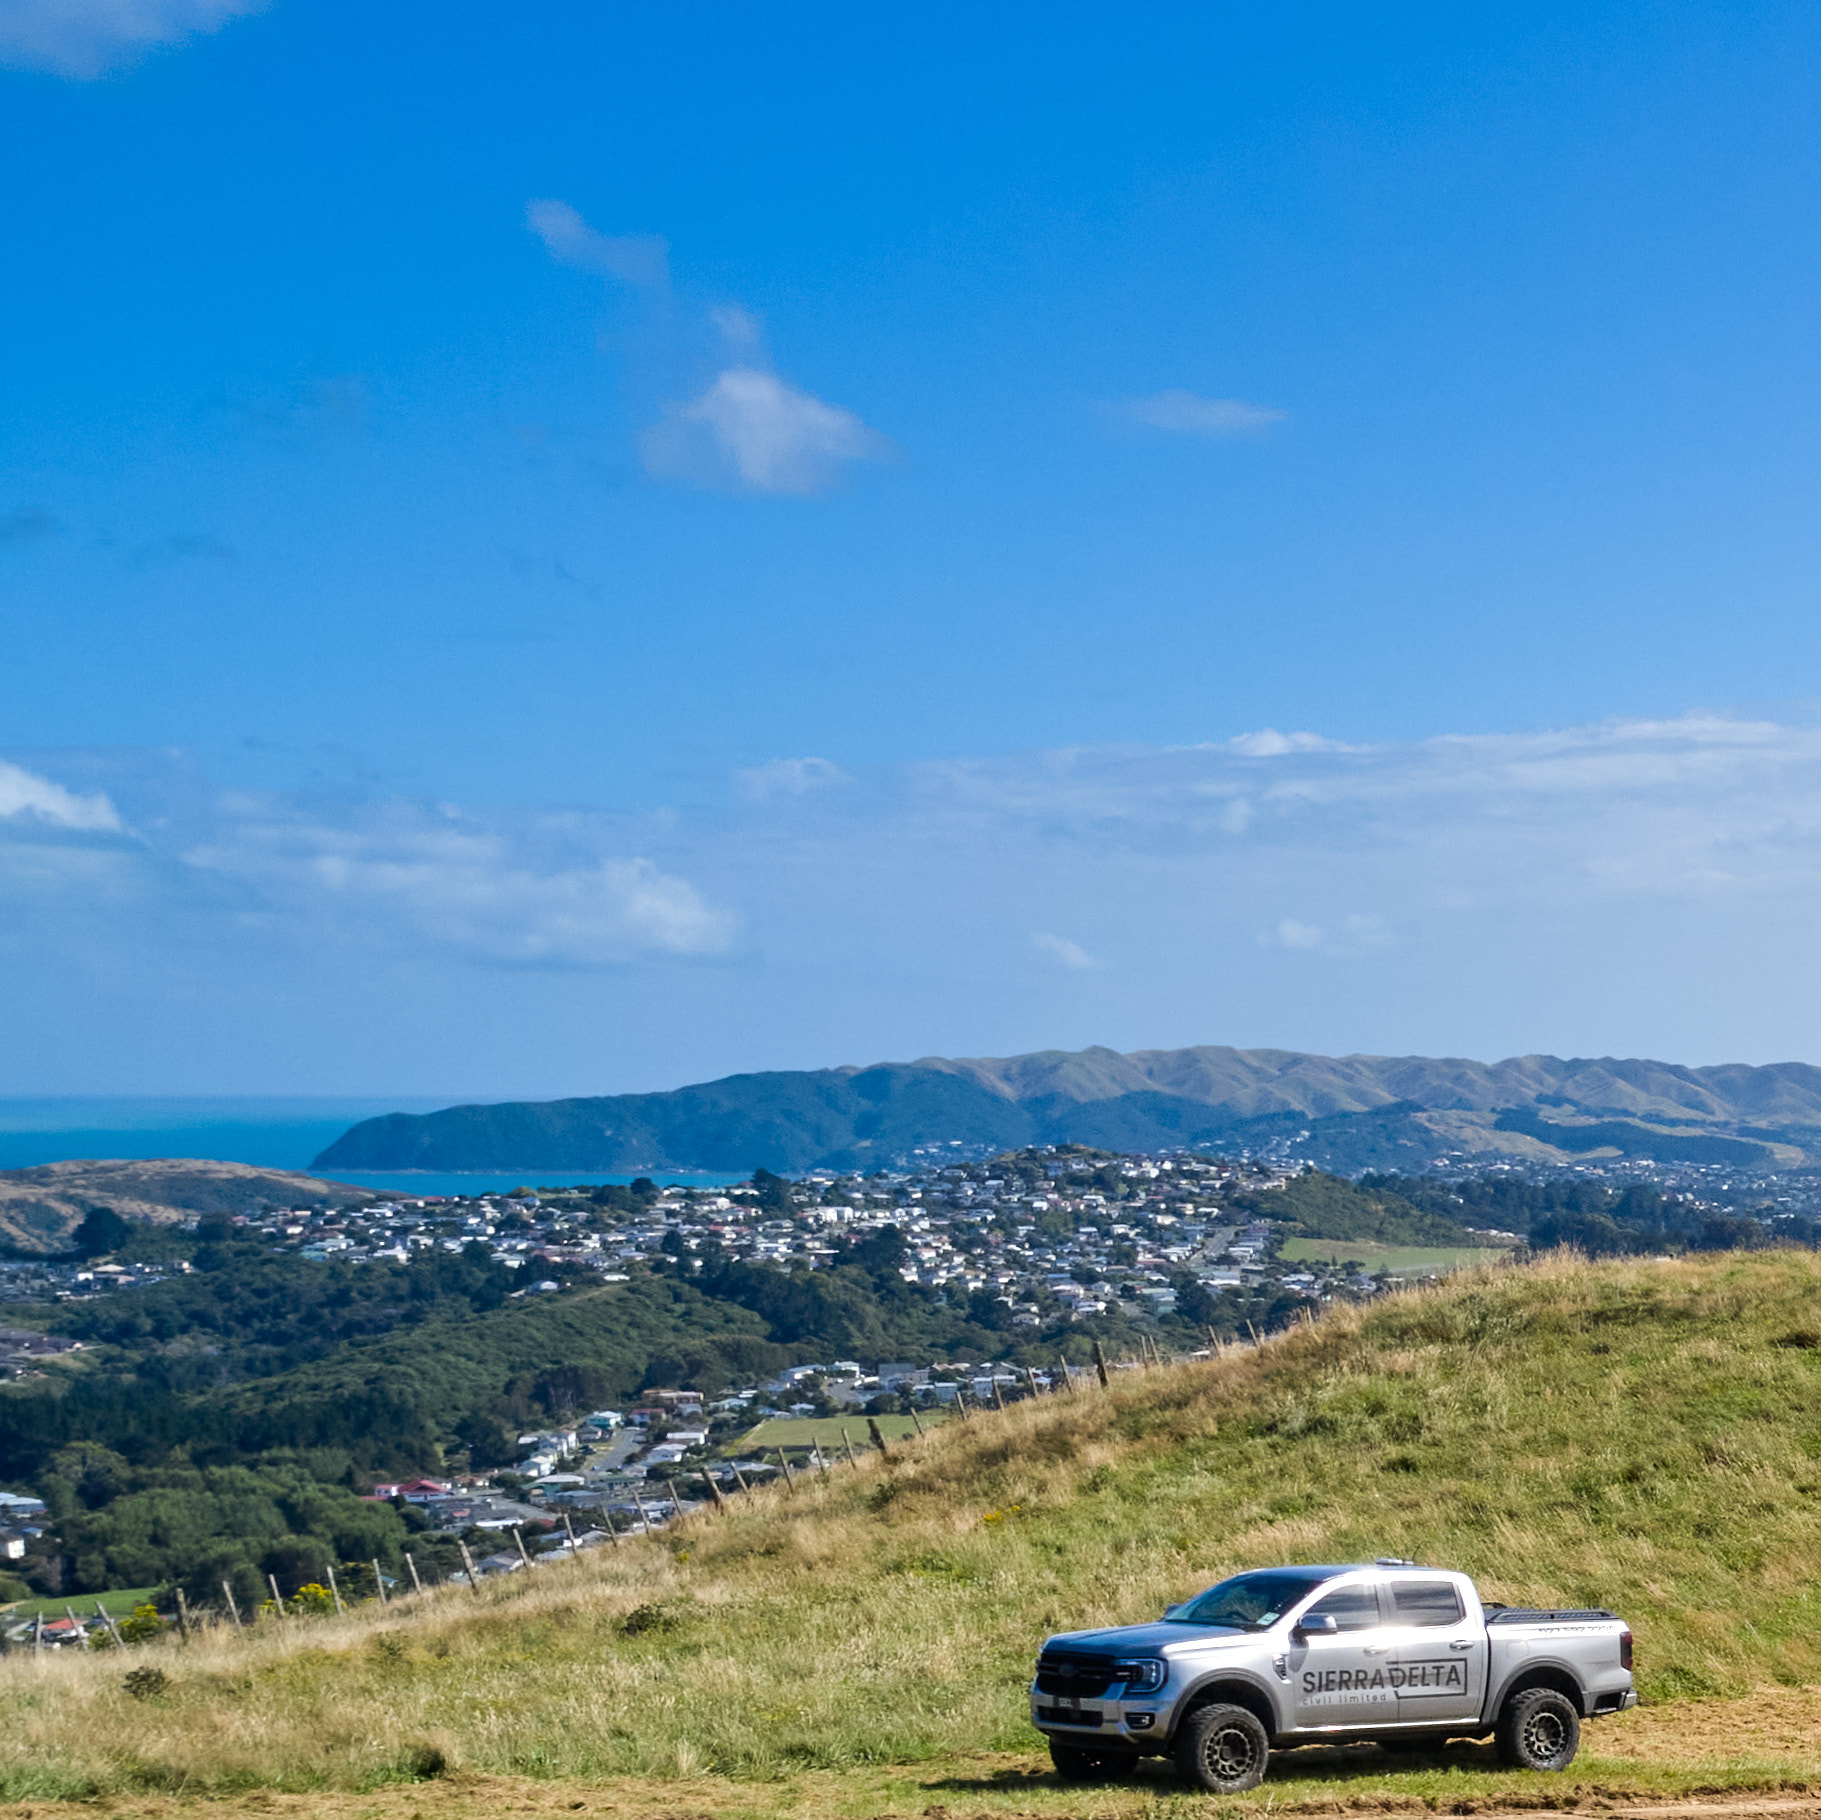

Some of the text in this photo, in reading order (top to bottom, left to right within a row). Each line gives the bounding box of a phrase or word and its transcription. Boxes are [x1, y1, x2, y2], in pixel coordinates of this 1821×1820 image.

[1303, 1664, 1460, 1693] SIERRA DELTA
[1303, 1692, 1385, 1705] civil limited
